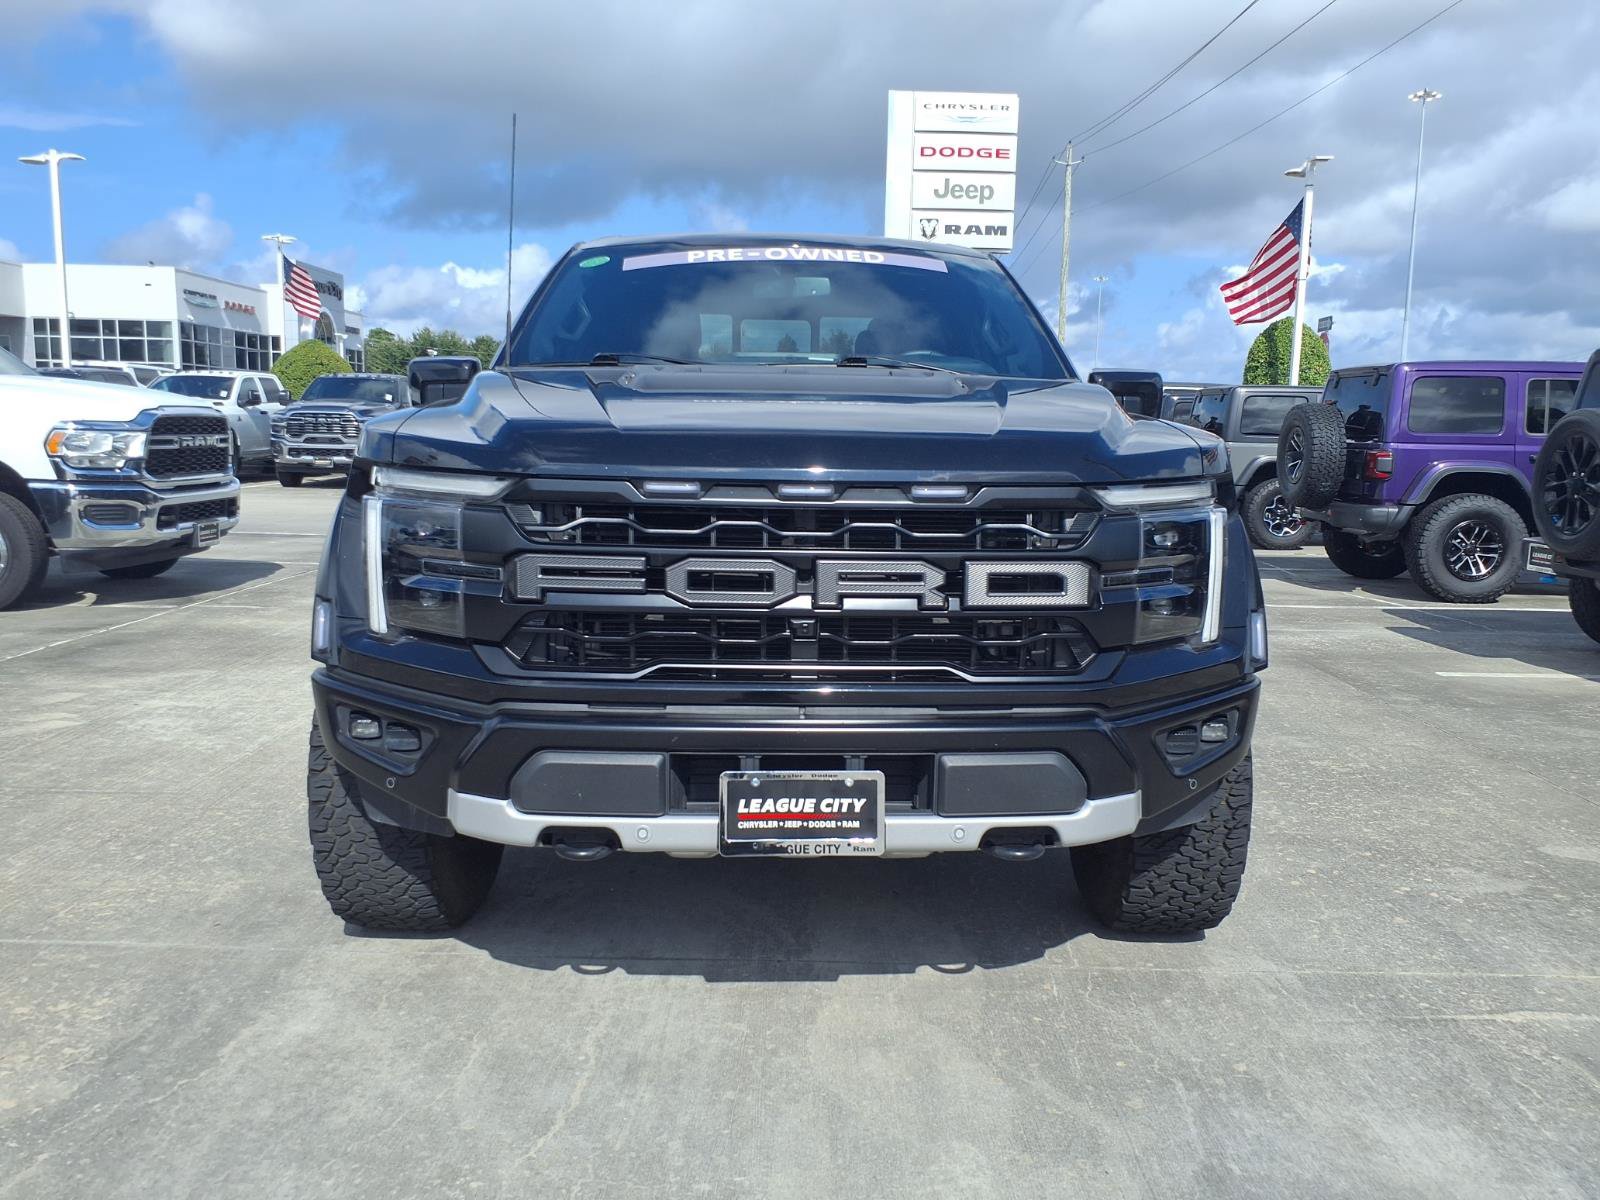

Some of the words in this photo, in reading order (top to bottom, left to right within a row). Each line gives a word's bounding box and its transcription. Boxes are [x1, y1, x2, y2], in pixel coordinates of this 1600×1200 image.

[923, 103, 1010, 111] CHRYSLER
[920, 146, 1010, 159] DODGE
[934, 178, 994, 204] Jeep
[944, 224, 1008, 236] RAM
[687, 246, 885, 263] PRE-OWNED
[181, 435, 219, 447] RAM
[514, 553, 1092, 609] FORD
[737, 798, 815, 813] LEAGUE
[820, 798, 867, 813] CITY
[737, 820, 778, 829] CHRYSLER
[783, 820, 803, 829] JEEP
[808, 820, 837, 829] DODGE
[842, 820, 860, 829] RAM
[786, 844, 810, 855] GUE
[814, 844, 842, 855] CITY
